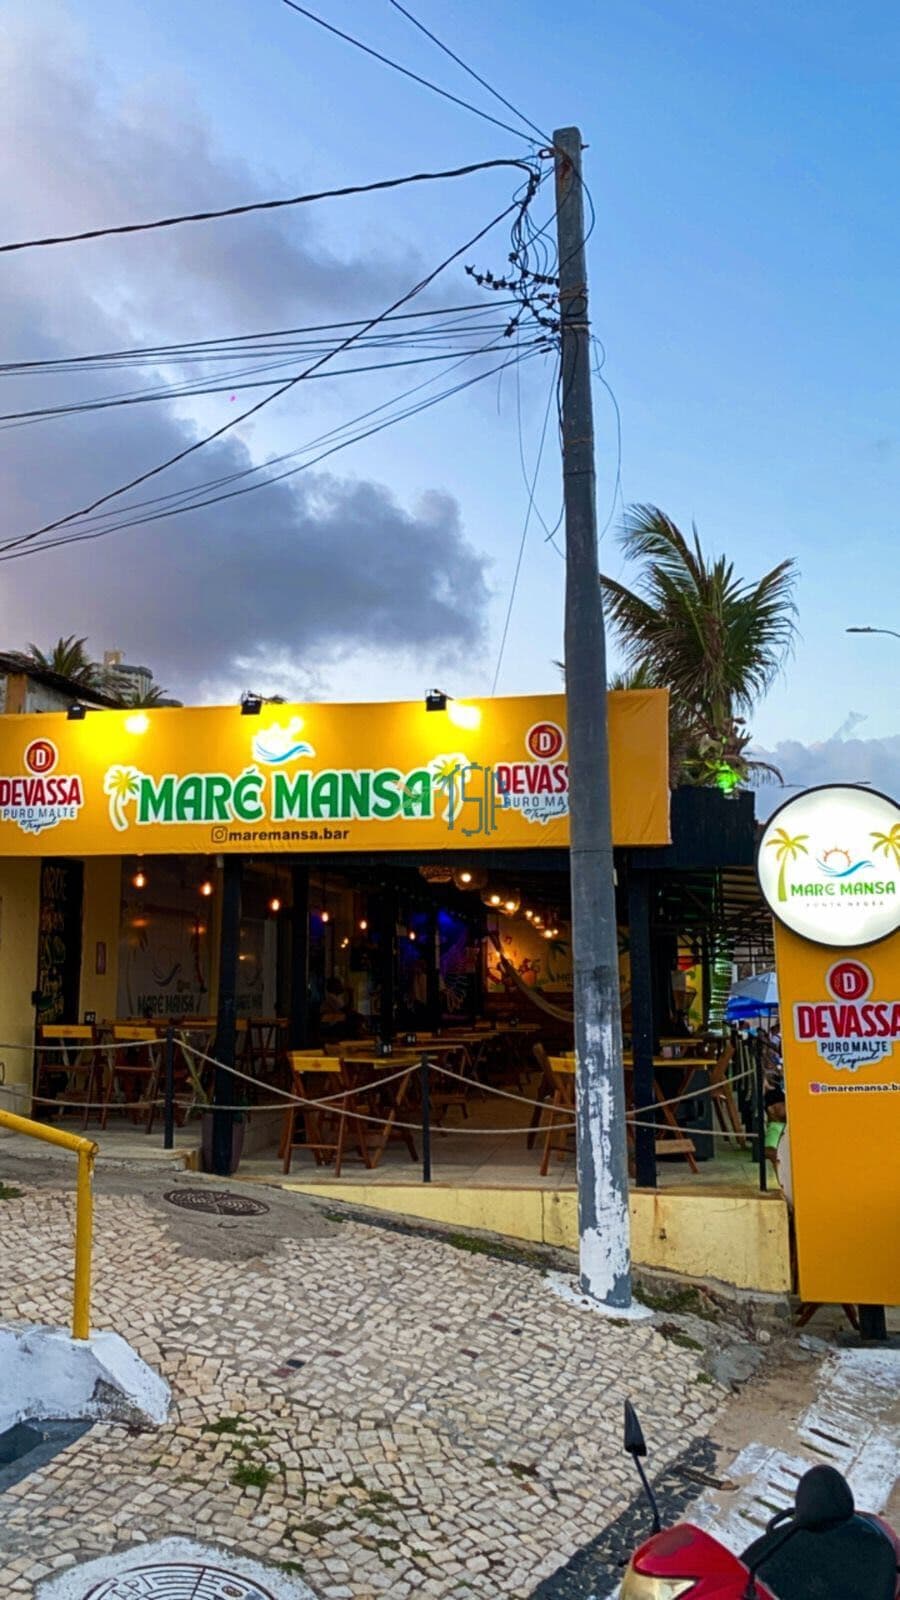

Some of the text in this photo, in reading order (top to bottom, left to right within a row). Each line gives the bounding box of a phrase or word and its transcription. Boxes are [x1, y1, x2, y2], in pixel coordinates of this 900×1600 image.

[497, 764, 568, 794] DEVAS
[0, 778, 81, 806] DEVASSA
[273, 771, 432, 819] MANSA
[3, 807, 76, 819] PURO MALTE
[228, 827, 350, 841] maremansa.bar
[840, 881, 896, 896] MANSA
[820, 1040, 889, 1053] PURO MALTE
